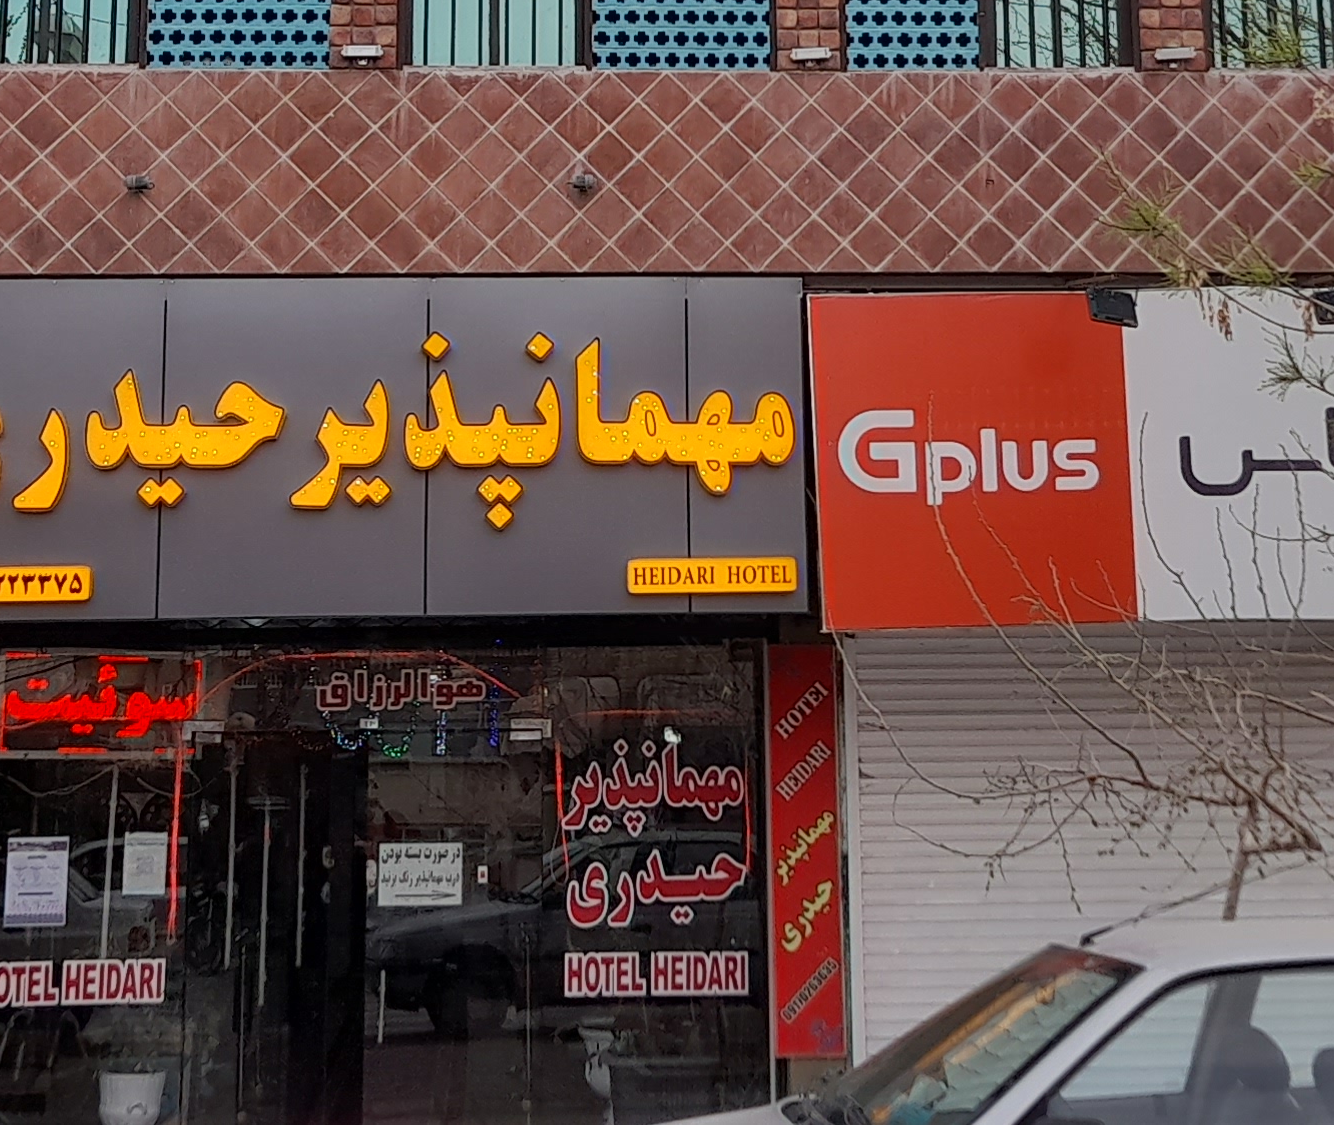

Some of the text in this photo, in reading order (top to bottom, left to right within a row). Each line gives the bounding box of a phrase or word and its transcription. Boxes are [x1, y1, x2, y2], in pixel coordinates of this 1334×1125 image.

[289, 331, 797, 531] مهمانپذیر
[837, 408, 1099, 505] Gplus
[633, 565, 792, 586] HEIDARI HOTEL
[562, 739, 745, 836] مهمانپذیر
[774, 739, 832, 802] HEIDARI
[381, 846, 461, 864] در صورت بسته بودن
[776, 811, 834, 886] مهمانپذیر
[568, 849, 748, 927] حیدری
[781, 879, 833, 952] حیدری
[61, 958, 166, 1005] HEIDARI
[564, 951, 749, 997] HOTEL HEIDARI
